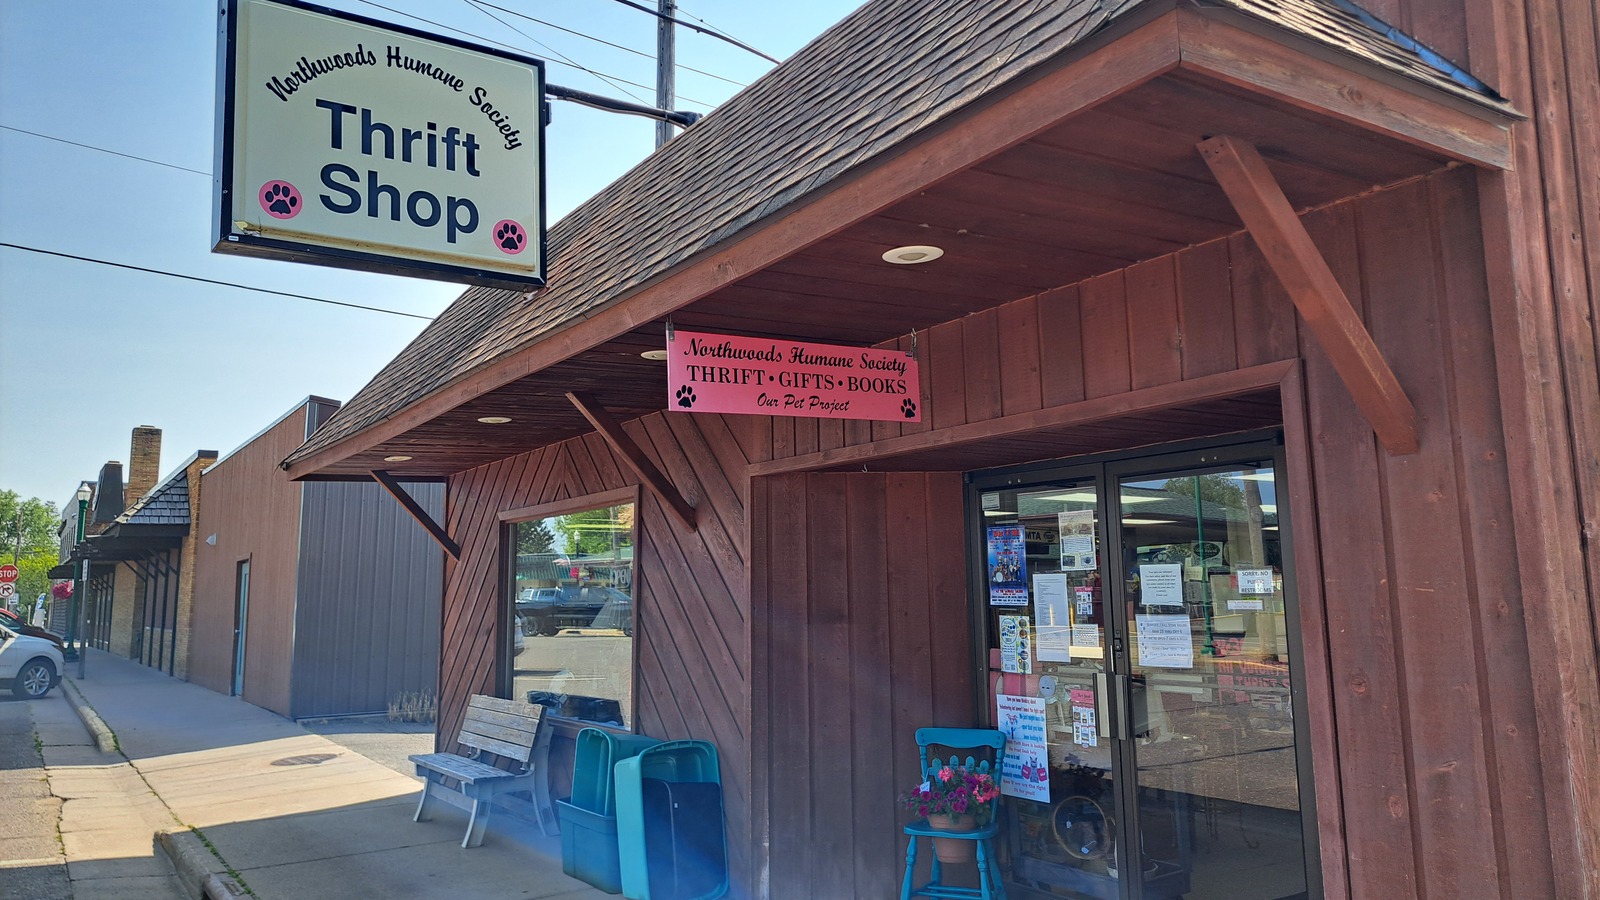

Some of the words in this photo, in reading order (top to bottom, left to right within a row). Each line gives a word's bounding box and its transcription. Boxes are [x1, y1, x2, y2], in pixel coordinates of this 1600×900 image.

[266, 43, 377, 102] Northwoods
[386, 45, 465, 92] Humane
[469, 86, 523, 151] Society
[315, 98, 481, 178] Thrift
[319, 163, 480, 244] Shop
[684, 338, 783, 363] Northwoods
[788, 346, 854, 368] Humane
[859, 353, 907, 376] Society
[687, 364, 766, 386] THRIFT
[778, 371, 835, 391] GIFTS
[847, 376, 907, 395] BOOKS
[757, 392, 779, 408] Our
[783, 393, 807, 410] Pet
[808, 396, 850, 414] Project
[0, 570, 17, 578] STOP
